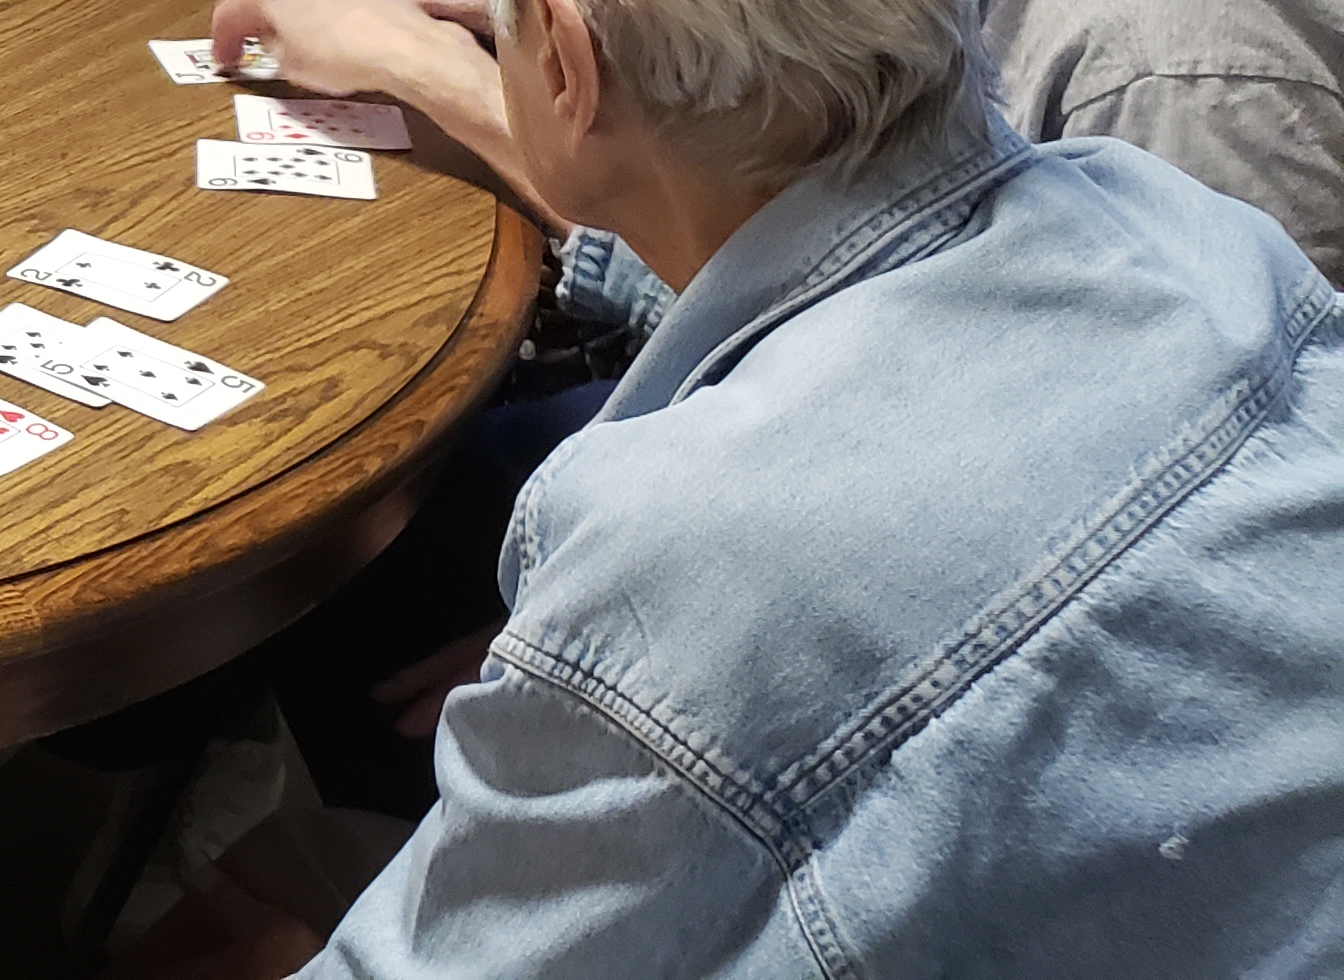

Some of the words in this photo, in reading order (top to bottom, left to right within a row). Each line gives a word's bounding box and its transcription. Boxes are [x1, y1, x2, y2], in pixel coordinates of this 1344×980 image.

[175, 72, 205, 81] J
[19, 267, 53, 282] 2
[183, 270, 217, 288] 2
[40, 359, 75, 376] 5
[220, 374, 257, 395] 5
[25, 422, 60, 442] 8
